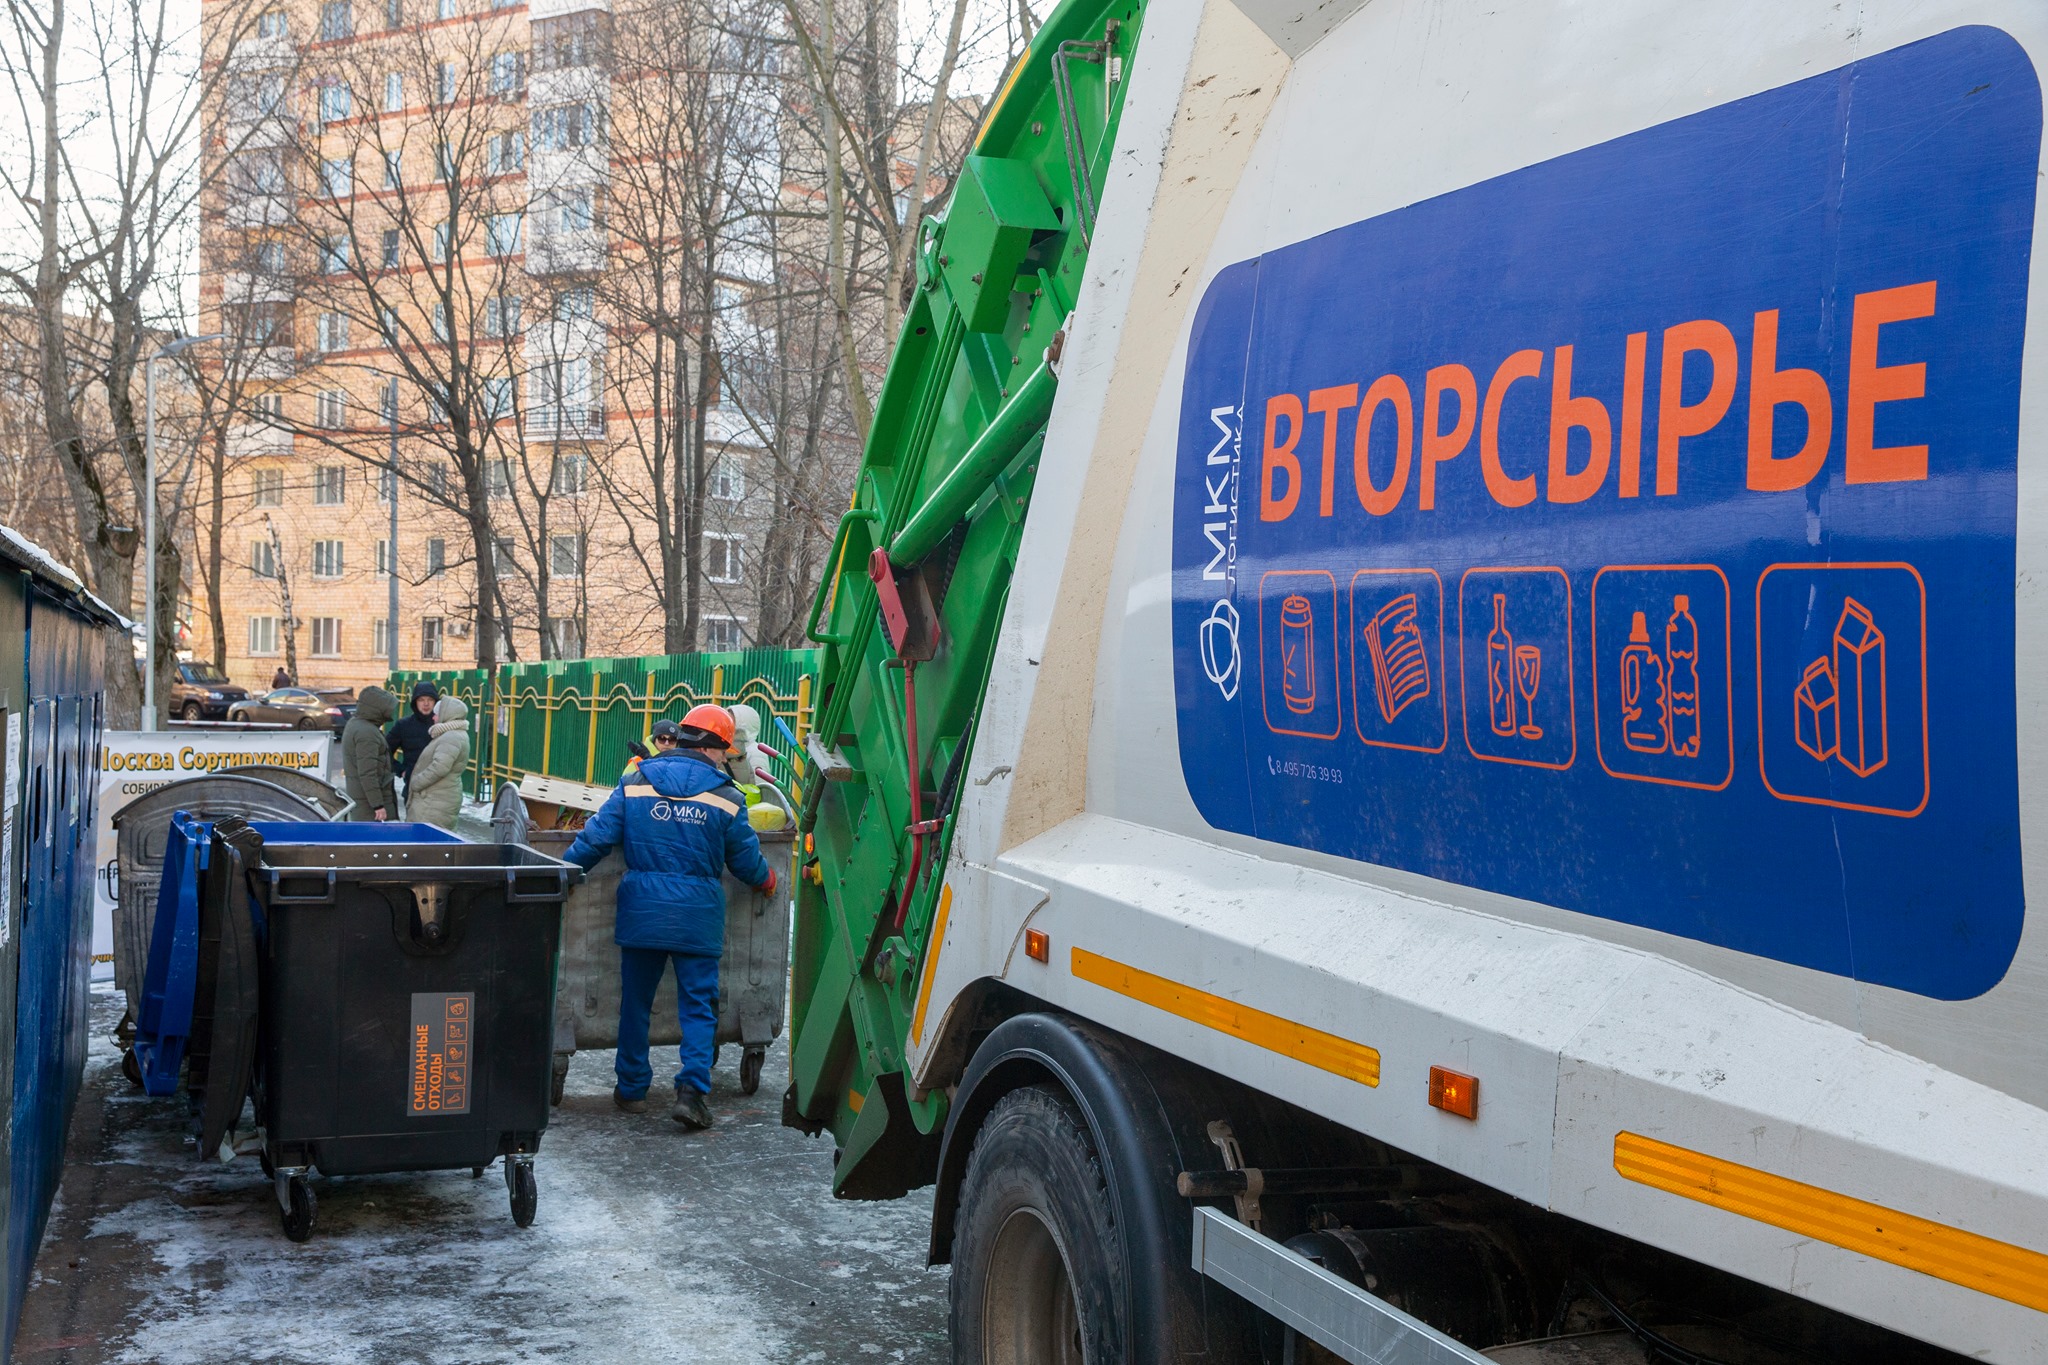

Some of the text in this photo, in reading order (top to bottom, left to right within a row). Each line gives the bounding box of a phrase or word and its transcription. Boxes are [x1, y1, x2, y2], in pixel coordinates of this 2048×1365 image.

[1260, 280, 1937, 522] ВТОРСЫРЬЕ
[1203, 405, 1235, 581] МКМ
[1227, 406, 1244, 585] ЛОГИСТИКА
[673, 805, 707, 820] МКМ
[1276, 760, 1343, 784] 8 495 726 39 93
[413, 1024, 428, 1111] СМЕШАННЫЕ
[428, 1053, 443, 1111] ОТХОДЫ
